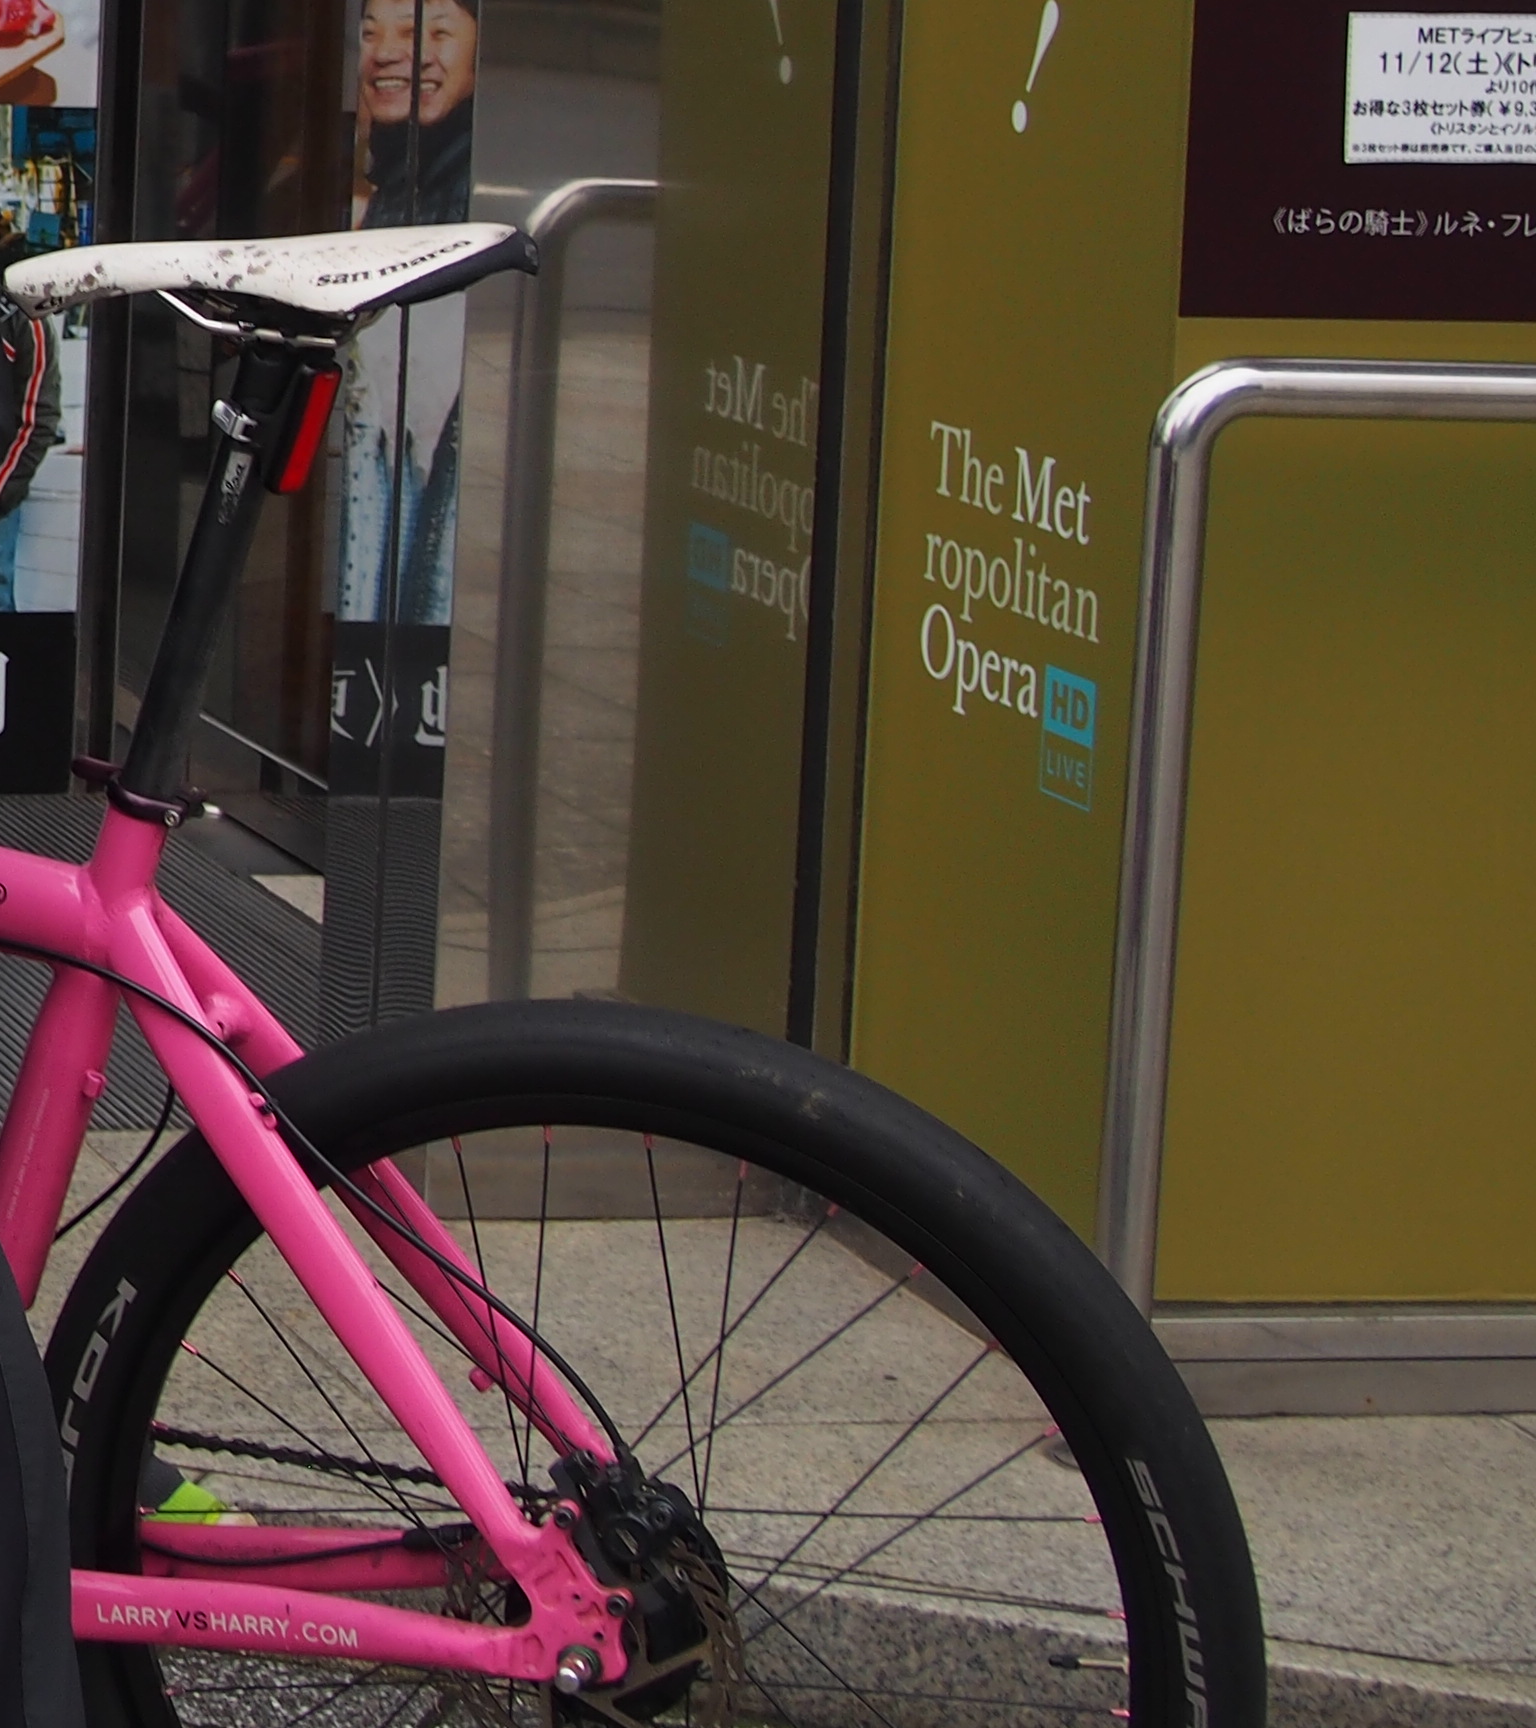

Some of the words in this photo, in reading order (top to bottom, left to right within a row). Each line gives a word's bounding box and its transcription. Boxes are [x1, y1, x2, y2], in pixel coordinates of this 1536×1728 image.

[930, 420, 1005, 517] The
[1012, 446, 1091, 545] Met
[924, 532, 1099, 643] ropolitan
[921, 603, 1038, 715] Opera
[1050, 679, 1089, 731] HD
[1046, 749, 1086, 789] LIVE
